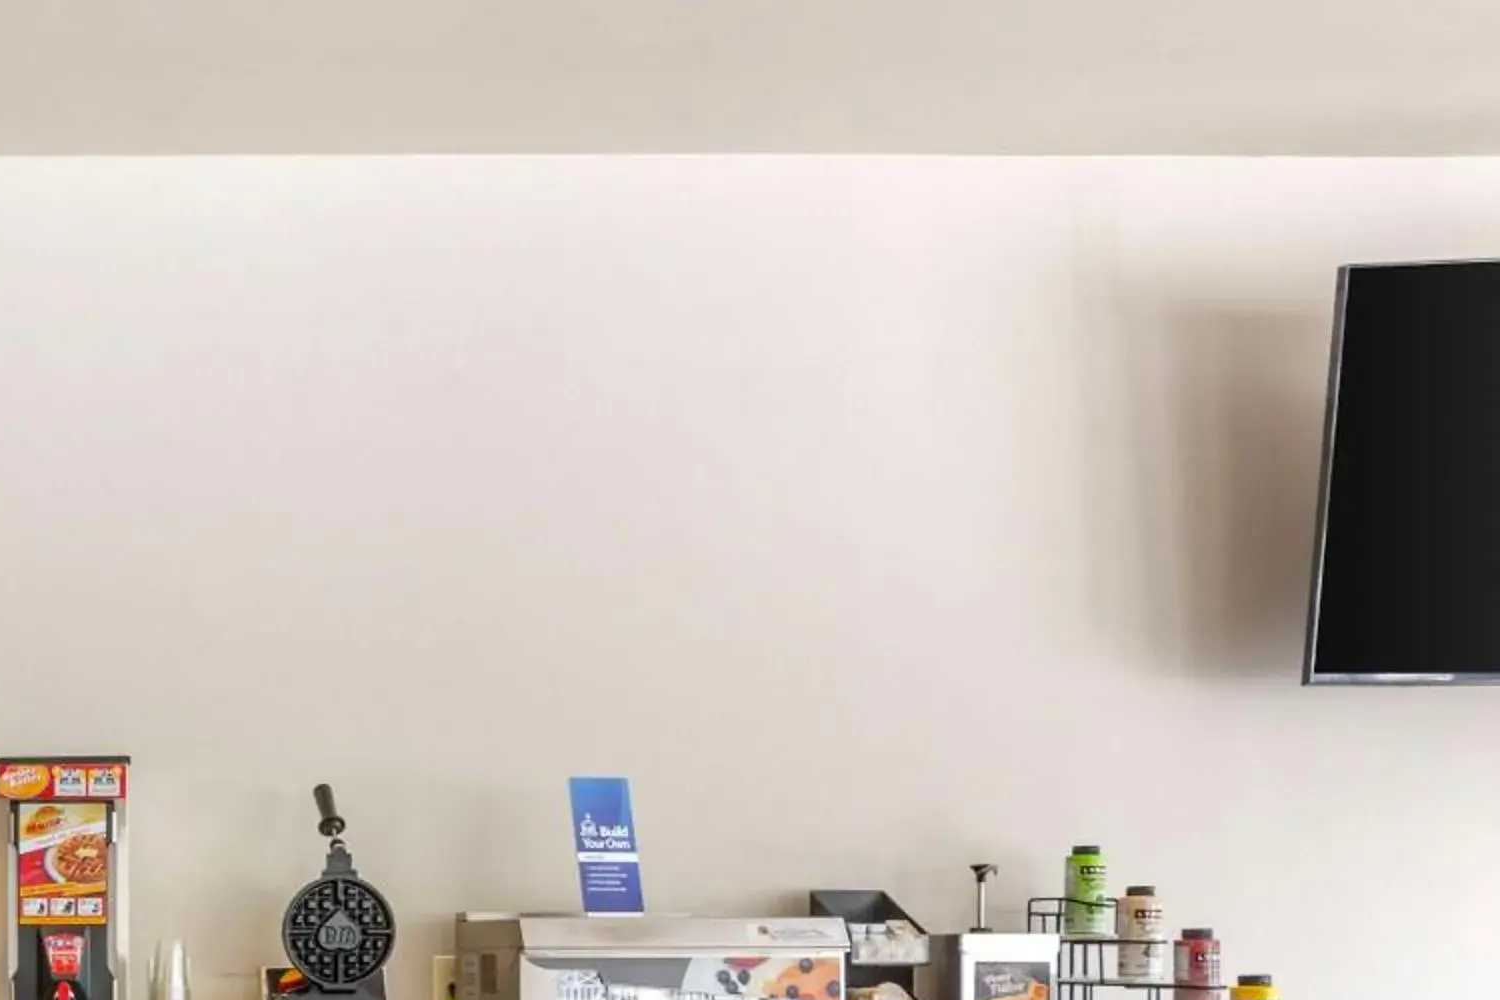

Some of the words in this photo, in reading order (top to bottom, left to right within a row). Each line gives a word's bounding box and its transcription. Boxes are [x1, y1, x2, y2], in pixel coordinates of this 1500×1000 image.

[599, 825, 629, 837] Build
[582, 837, 605, 849] Your
[606, 837, 631, 849] Own
